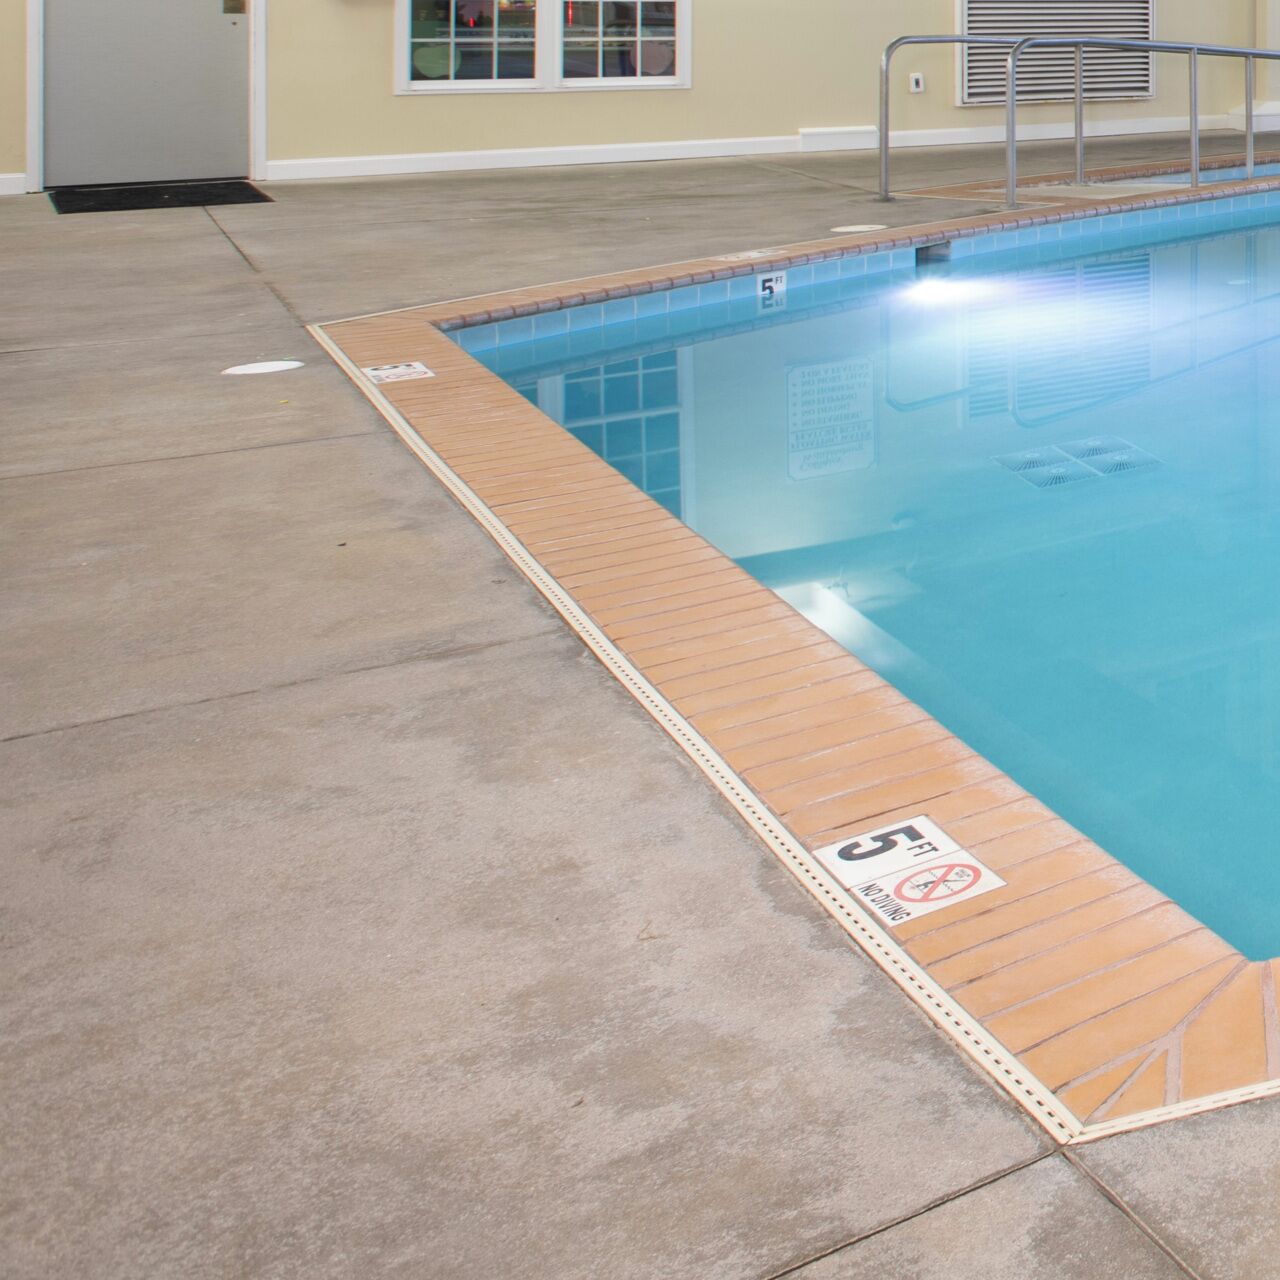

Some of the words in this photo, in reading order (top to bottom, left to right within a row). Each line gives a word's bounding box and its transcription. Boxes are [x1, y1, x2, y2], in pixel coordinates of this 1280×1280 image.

[761, 277, 775, 296] 5
[775, 276, 785, 285] FT
[837, 824, 926, 862] 5
[905, 840, 939, 859] FT
[858, 882, 884, 897] NO
[870, 893, 912, 921] DIVING
